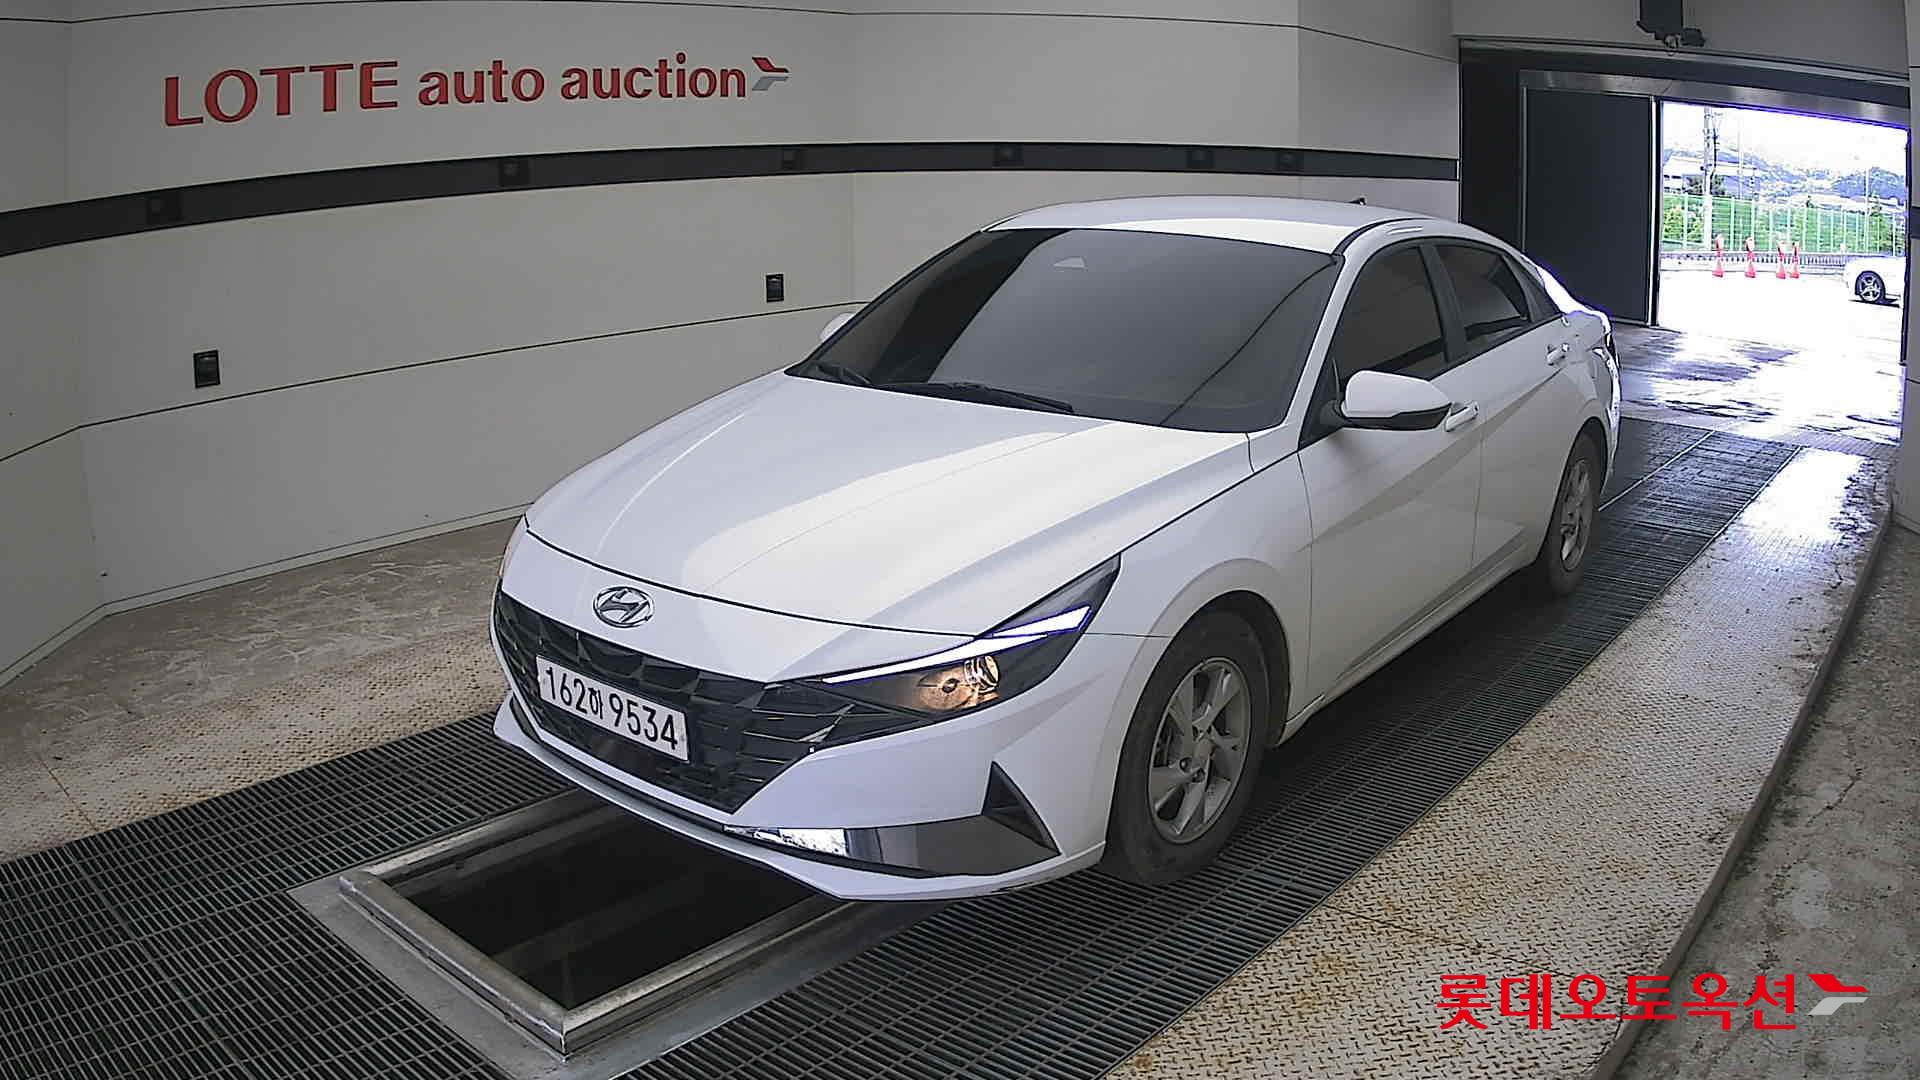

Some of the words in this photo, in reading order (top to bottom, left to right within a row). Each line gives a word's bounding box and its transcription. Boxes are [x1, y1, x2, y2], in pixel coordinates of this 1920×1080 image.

[164, 61, 398, 127] LOTTE
[418, 59, 546, 106] auto
[560, 53, 746, 101] auction
[609, 693, 678, 750] 9534
